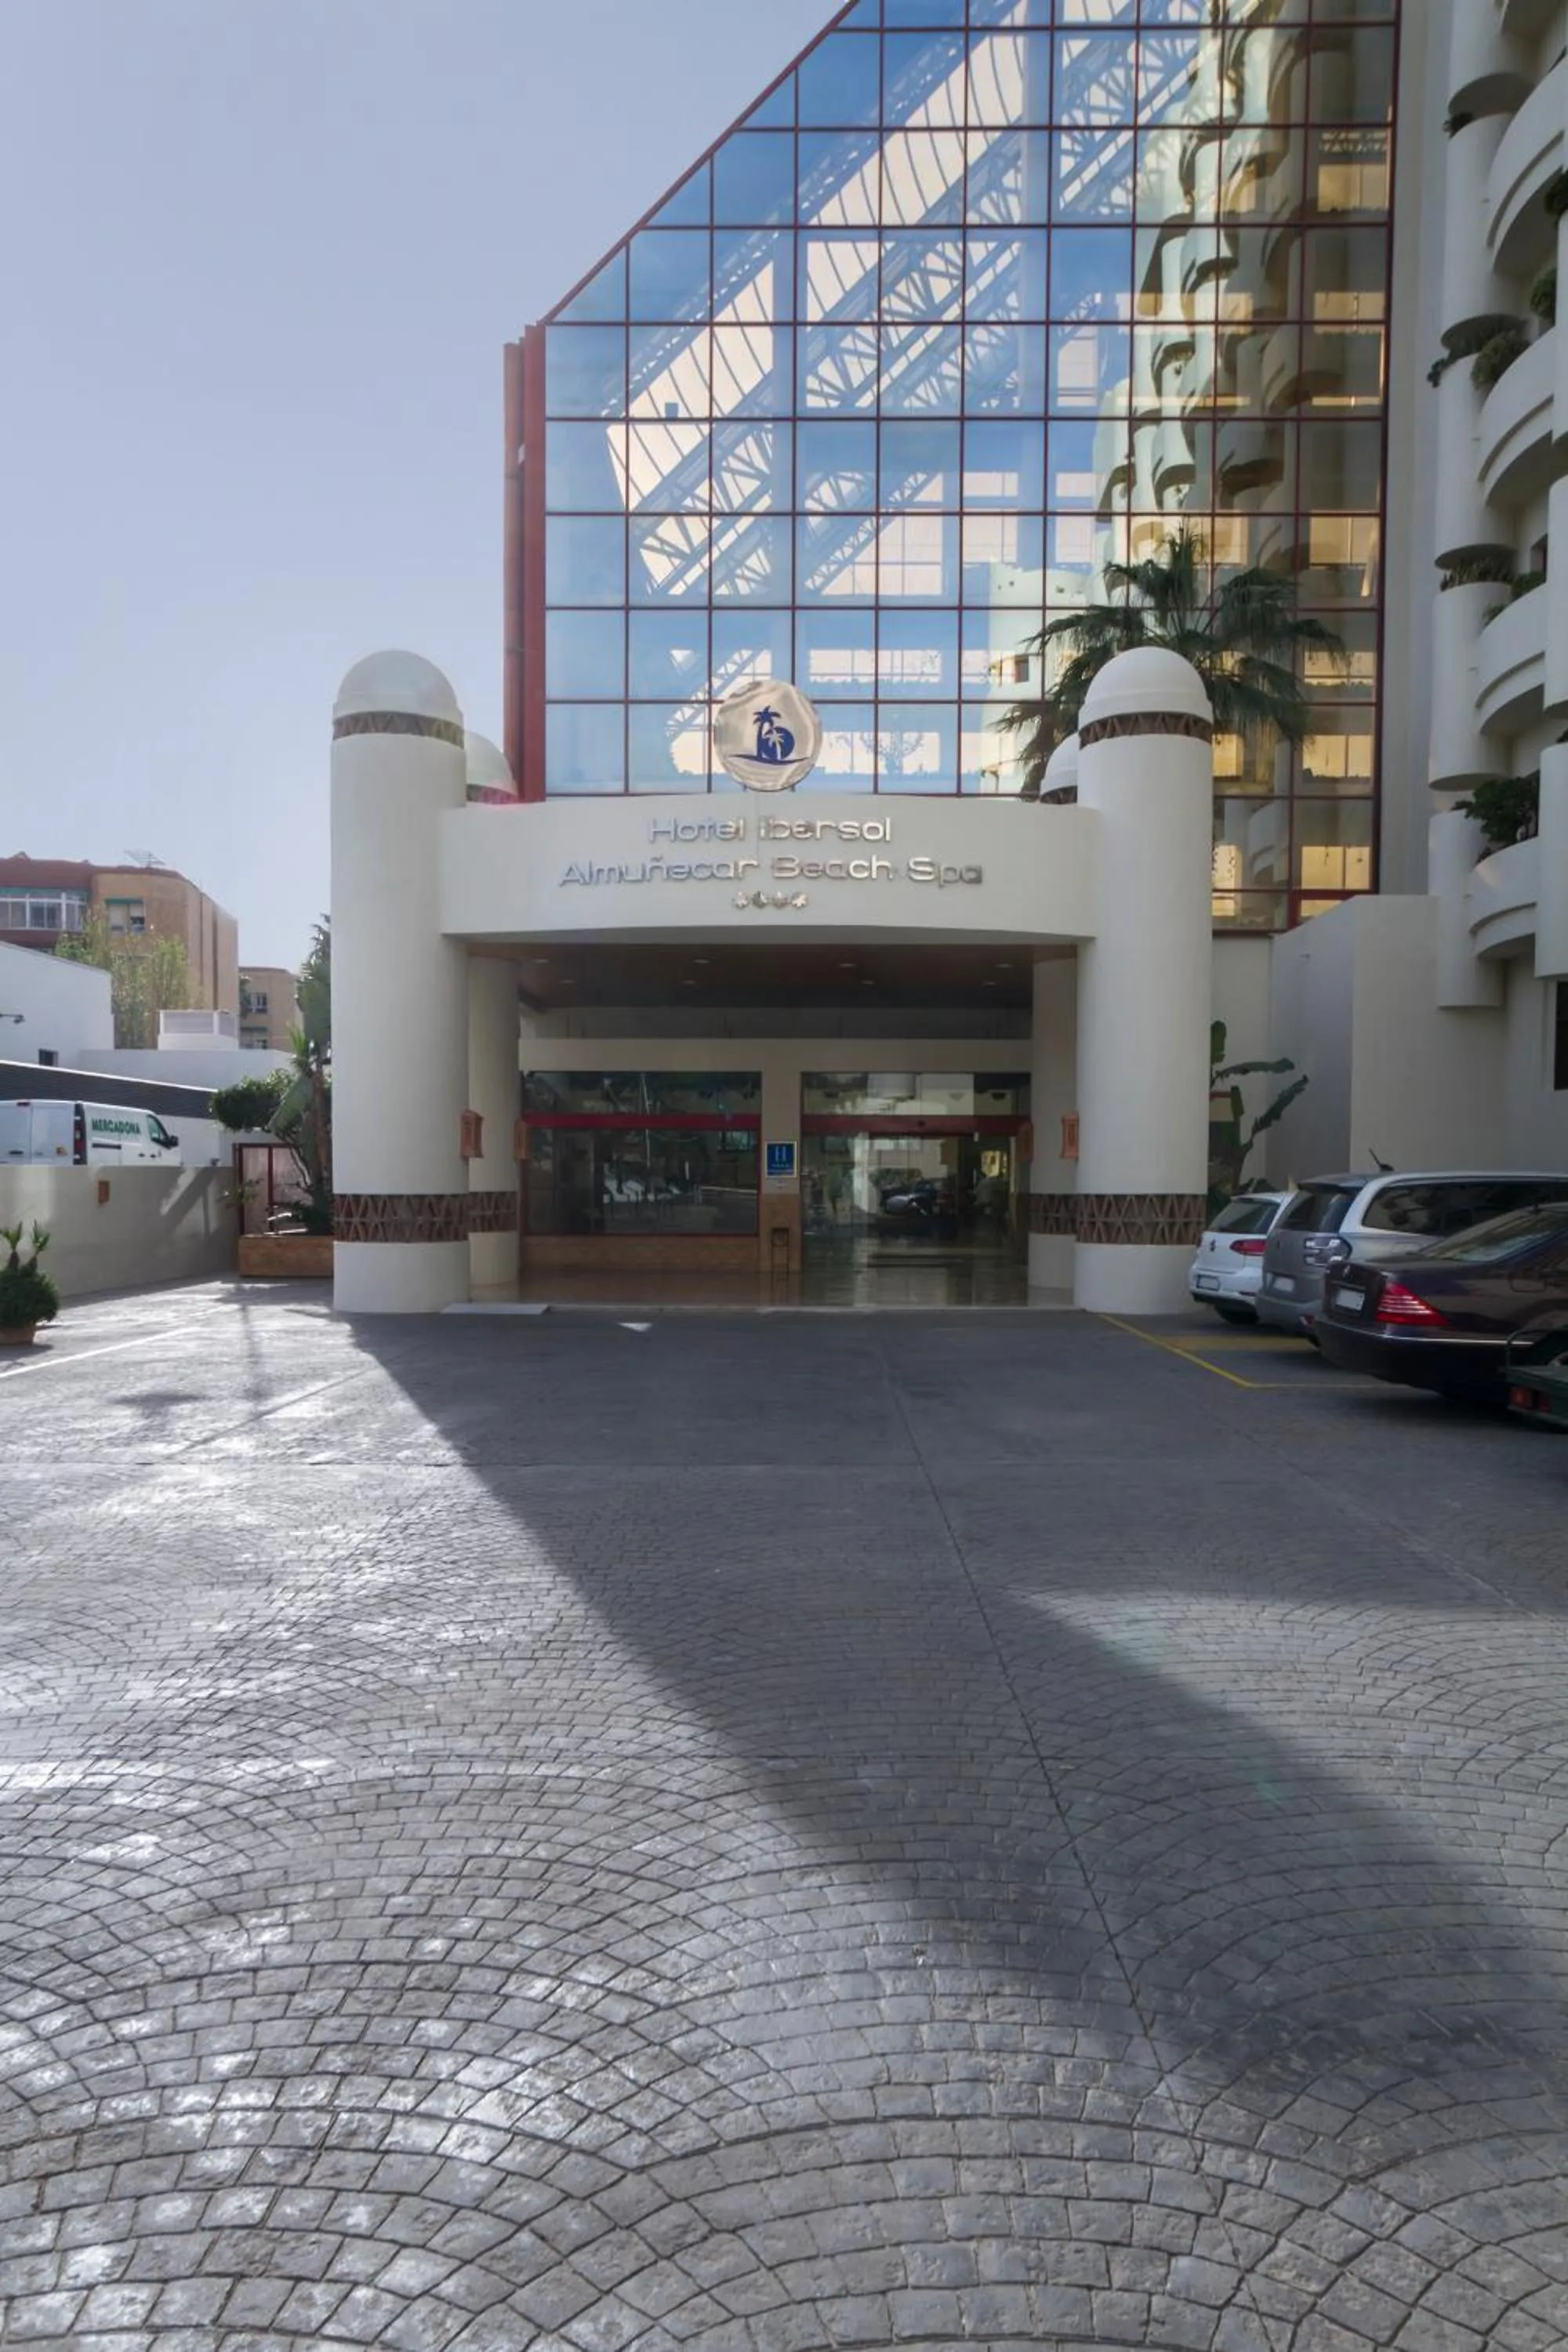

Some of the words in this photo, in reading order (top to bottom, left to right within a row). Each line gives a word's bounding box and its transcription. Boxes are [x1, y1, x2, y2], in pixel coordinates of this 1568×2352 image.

[649, 817, 745, 844] Hotel
[559, 855, 759, 887] Almuñecar
[771, 854, 894, 880] Beach
[907, 856, 983, 890] Spa
[91, 1117, 140, 1134] MERCADONA
